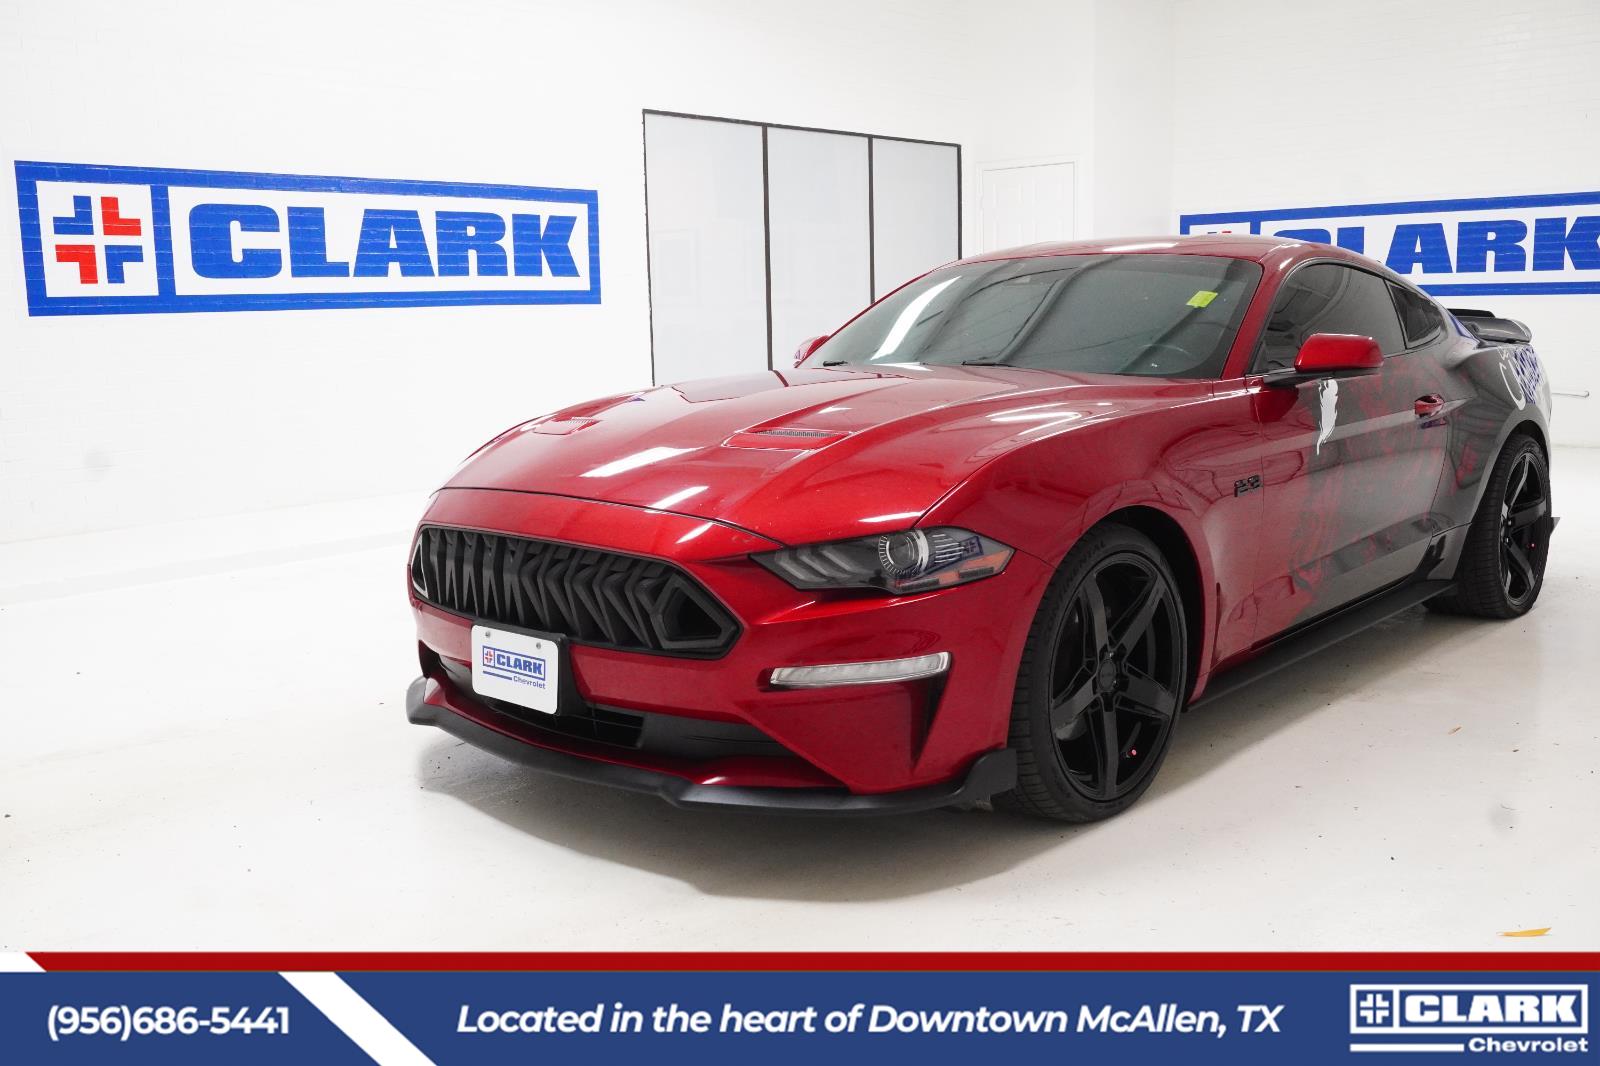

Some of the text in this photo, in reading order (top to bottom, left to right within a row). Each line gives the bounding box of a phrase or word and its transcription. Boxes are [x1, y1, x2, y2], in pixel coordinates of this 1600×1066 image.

[189, 202, 581, 279] CLARK
[496, 653, 543, 676] CLARK
[513, 676, 546, 690] Chevrolet
